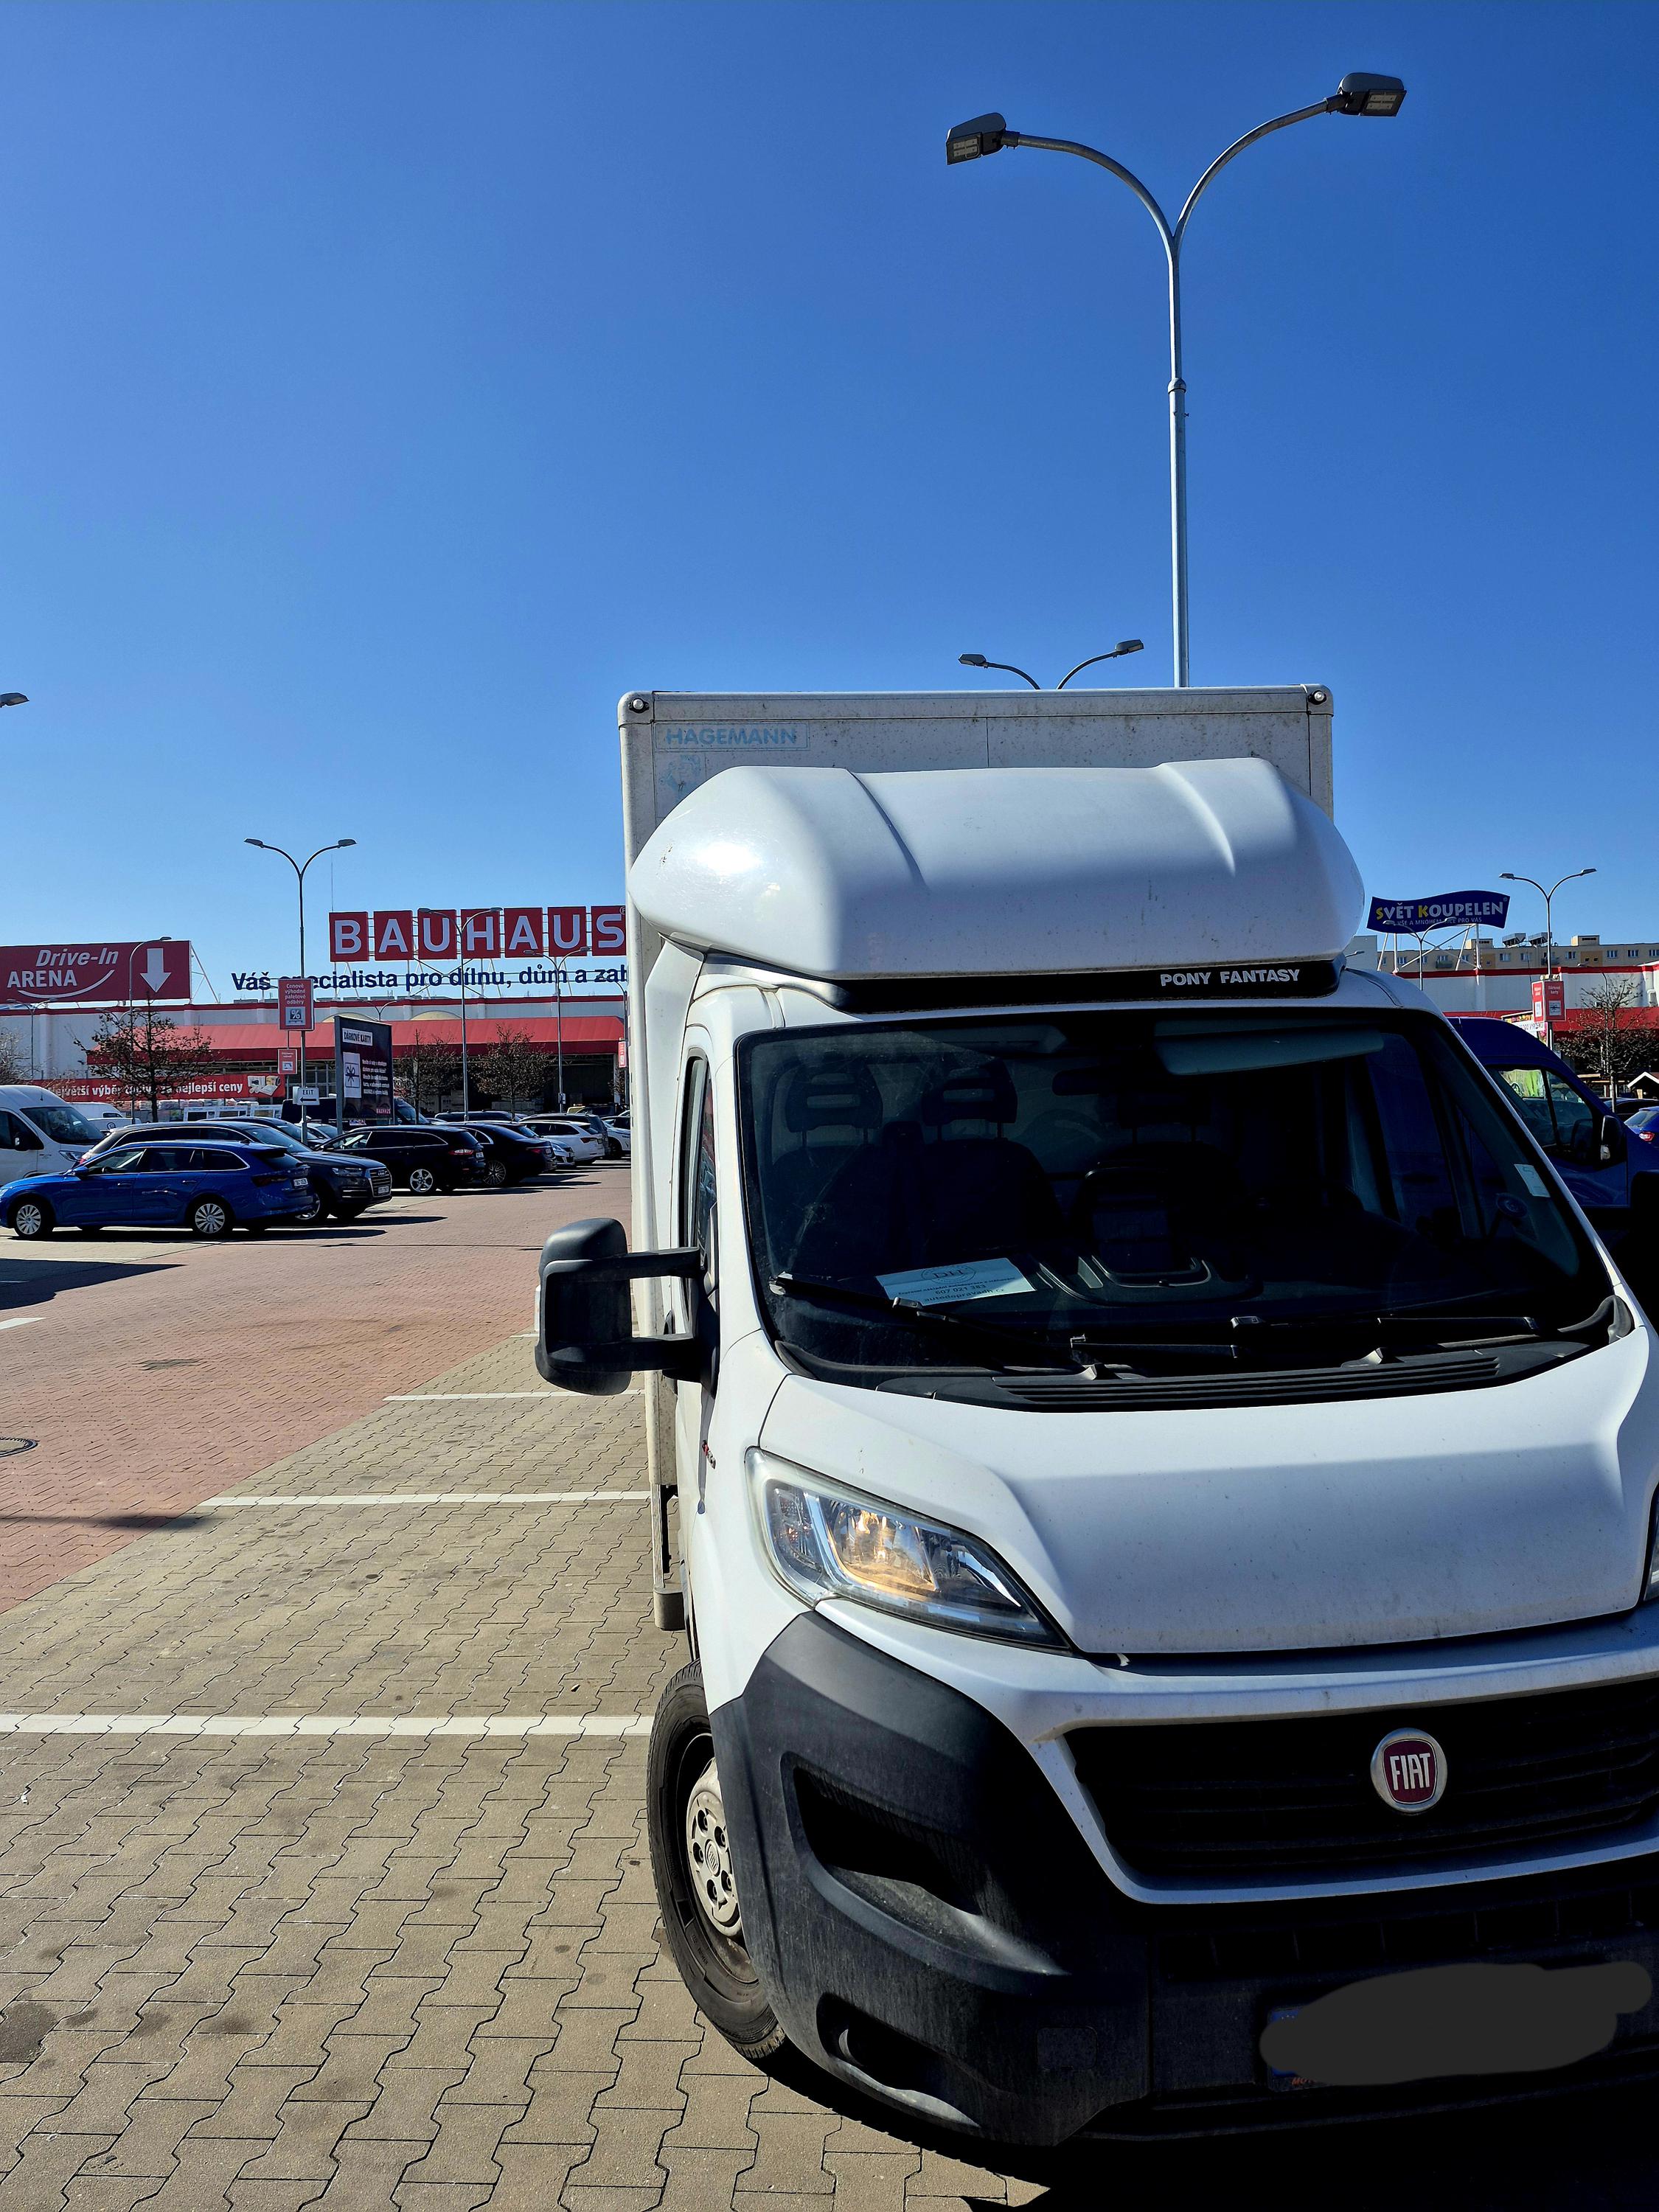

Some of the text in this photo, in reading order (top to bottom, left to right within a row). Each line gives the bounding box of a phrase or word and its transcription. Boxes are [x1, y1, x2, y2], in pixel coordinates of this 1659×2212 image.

[665, 728, 796, 745] HAGEMANN
[1376, 901, 1504, 920] SVĚT KOUPELEN
[334, 914, 626, 954] BAUHAUS
[35, 947, 119, 967] Drive-In
[7, 970, 77, 988] ARENA
[231, 971, 271, 991] Váš
[406, 972, 442, 992] pro
[449, 967, 511, 989] dílnu,
[518, 964, 567, 984] dům
[575, 969, 588, 984] a
[1160, 969, 1300, 987] PONY FANTASY
[219, 1083, 243, 1093] ceny
[1390, 1753, 1430, 1790] FIAT
